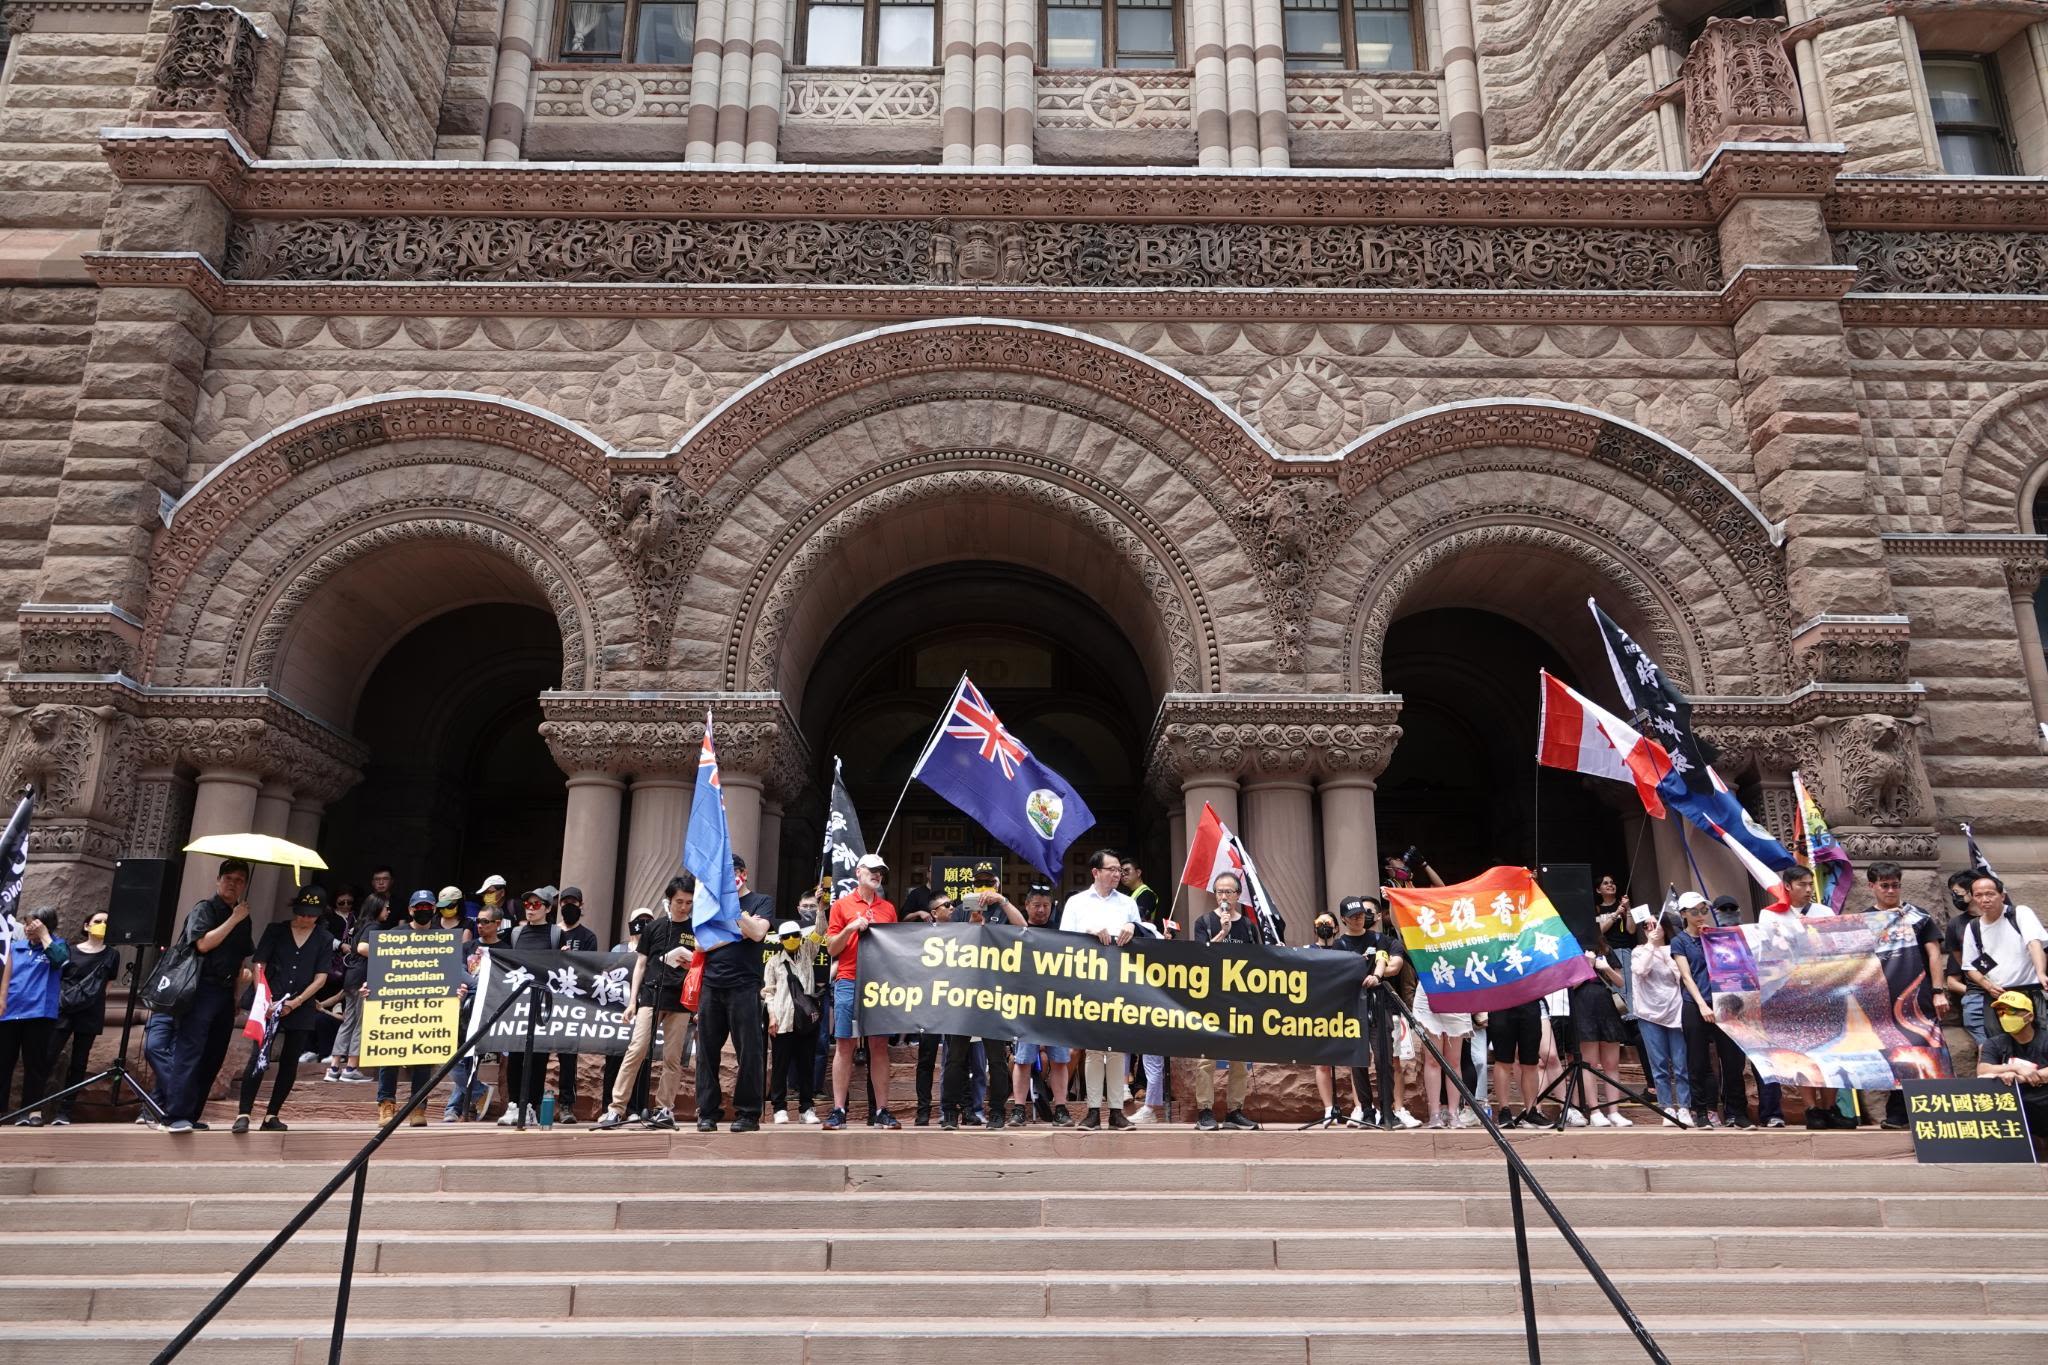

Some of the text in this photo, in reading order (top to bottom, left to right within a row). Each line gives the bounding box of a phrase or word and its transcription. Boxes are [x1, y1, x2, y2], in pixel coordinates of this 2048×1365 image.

[328, 230, 1618, 277] MUNICIPAL BUILDINGS
[943, 867, 976, 883] 願榮
[378, 932, 454, 944] Stop foreign
[1466, 934, 1490, 948] KONG
[391, 958, 439, 968] Protect
[921, 936, 1308, 1004] Stand with Hong Kong
[384, 972, 445, 983] Canadian
[378, 985, 450, 997] democracy
[381, 998, 444, 1011] Fight for
[863, 981, 1361, 1039] Stop Foreign Interference in Canada
[379, 1013, 443, 1025] freedom
[368, 1027, 451, 1041] Stand with
[366, 1043, 451, 1058] Hong Kong
[1910, 1091, 2018, 1114] 反外國滲透
[1915, 1119, 2025, 1140] 保加國民主
